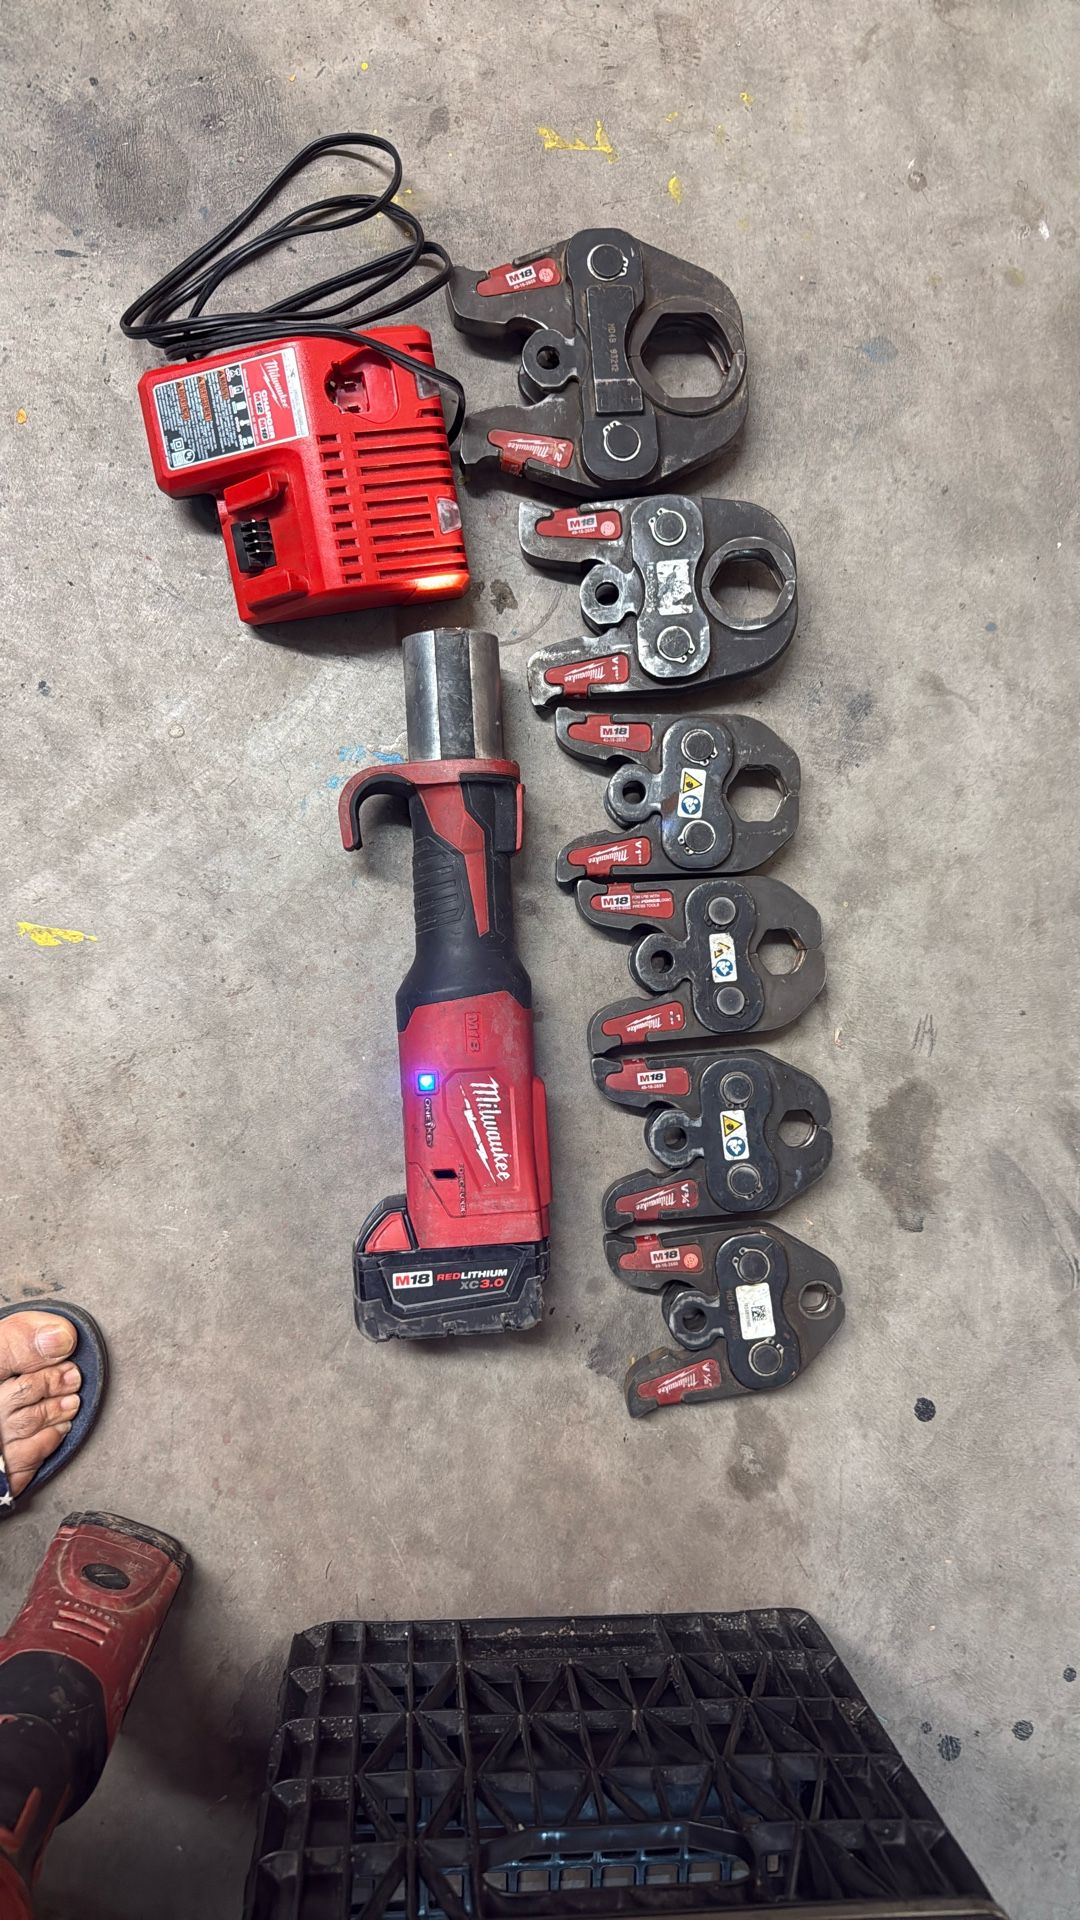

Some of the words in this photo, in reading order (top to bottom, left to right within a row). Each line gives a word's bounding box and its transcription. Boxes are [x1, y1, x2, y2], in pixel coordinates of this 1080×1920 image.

[509, 269, 532, 283] M18
[264, 359, 289, 409] Milwaukee
[254, 393, 263, 413] M12
[259, 419, 268, 439] M18
[260, 389, 276, 439] CHARGER
[507, 442, 549, 458] Milwaukee
[570, 518, 594, 528] M18
[564, 666, 605, 683] Milwaukee
[588, 849, 629, 864] Milwaukee
[603, 897, 628, 906] M18
[469, 1015, 479, 1051] M18
[627, 1017, 662, 1032] Milwaukee
[640, 1073, 663, 1082] M18
[470, 1074, 511, 1182] Milwaukee
[636, 1193, 676, 1210] Milwaukee
[653, 1250, 677, 1261] M18
[396, 1274, 429, 1286] M18
[436, 1269, 508, 1281] REDLITHIUM
[657, 1373, 698, 1394] Milwaukee
